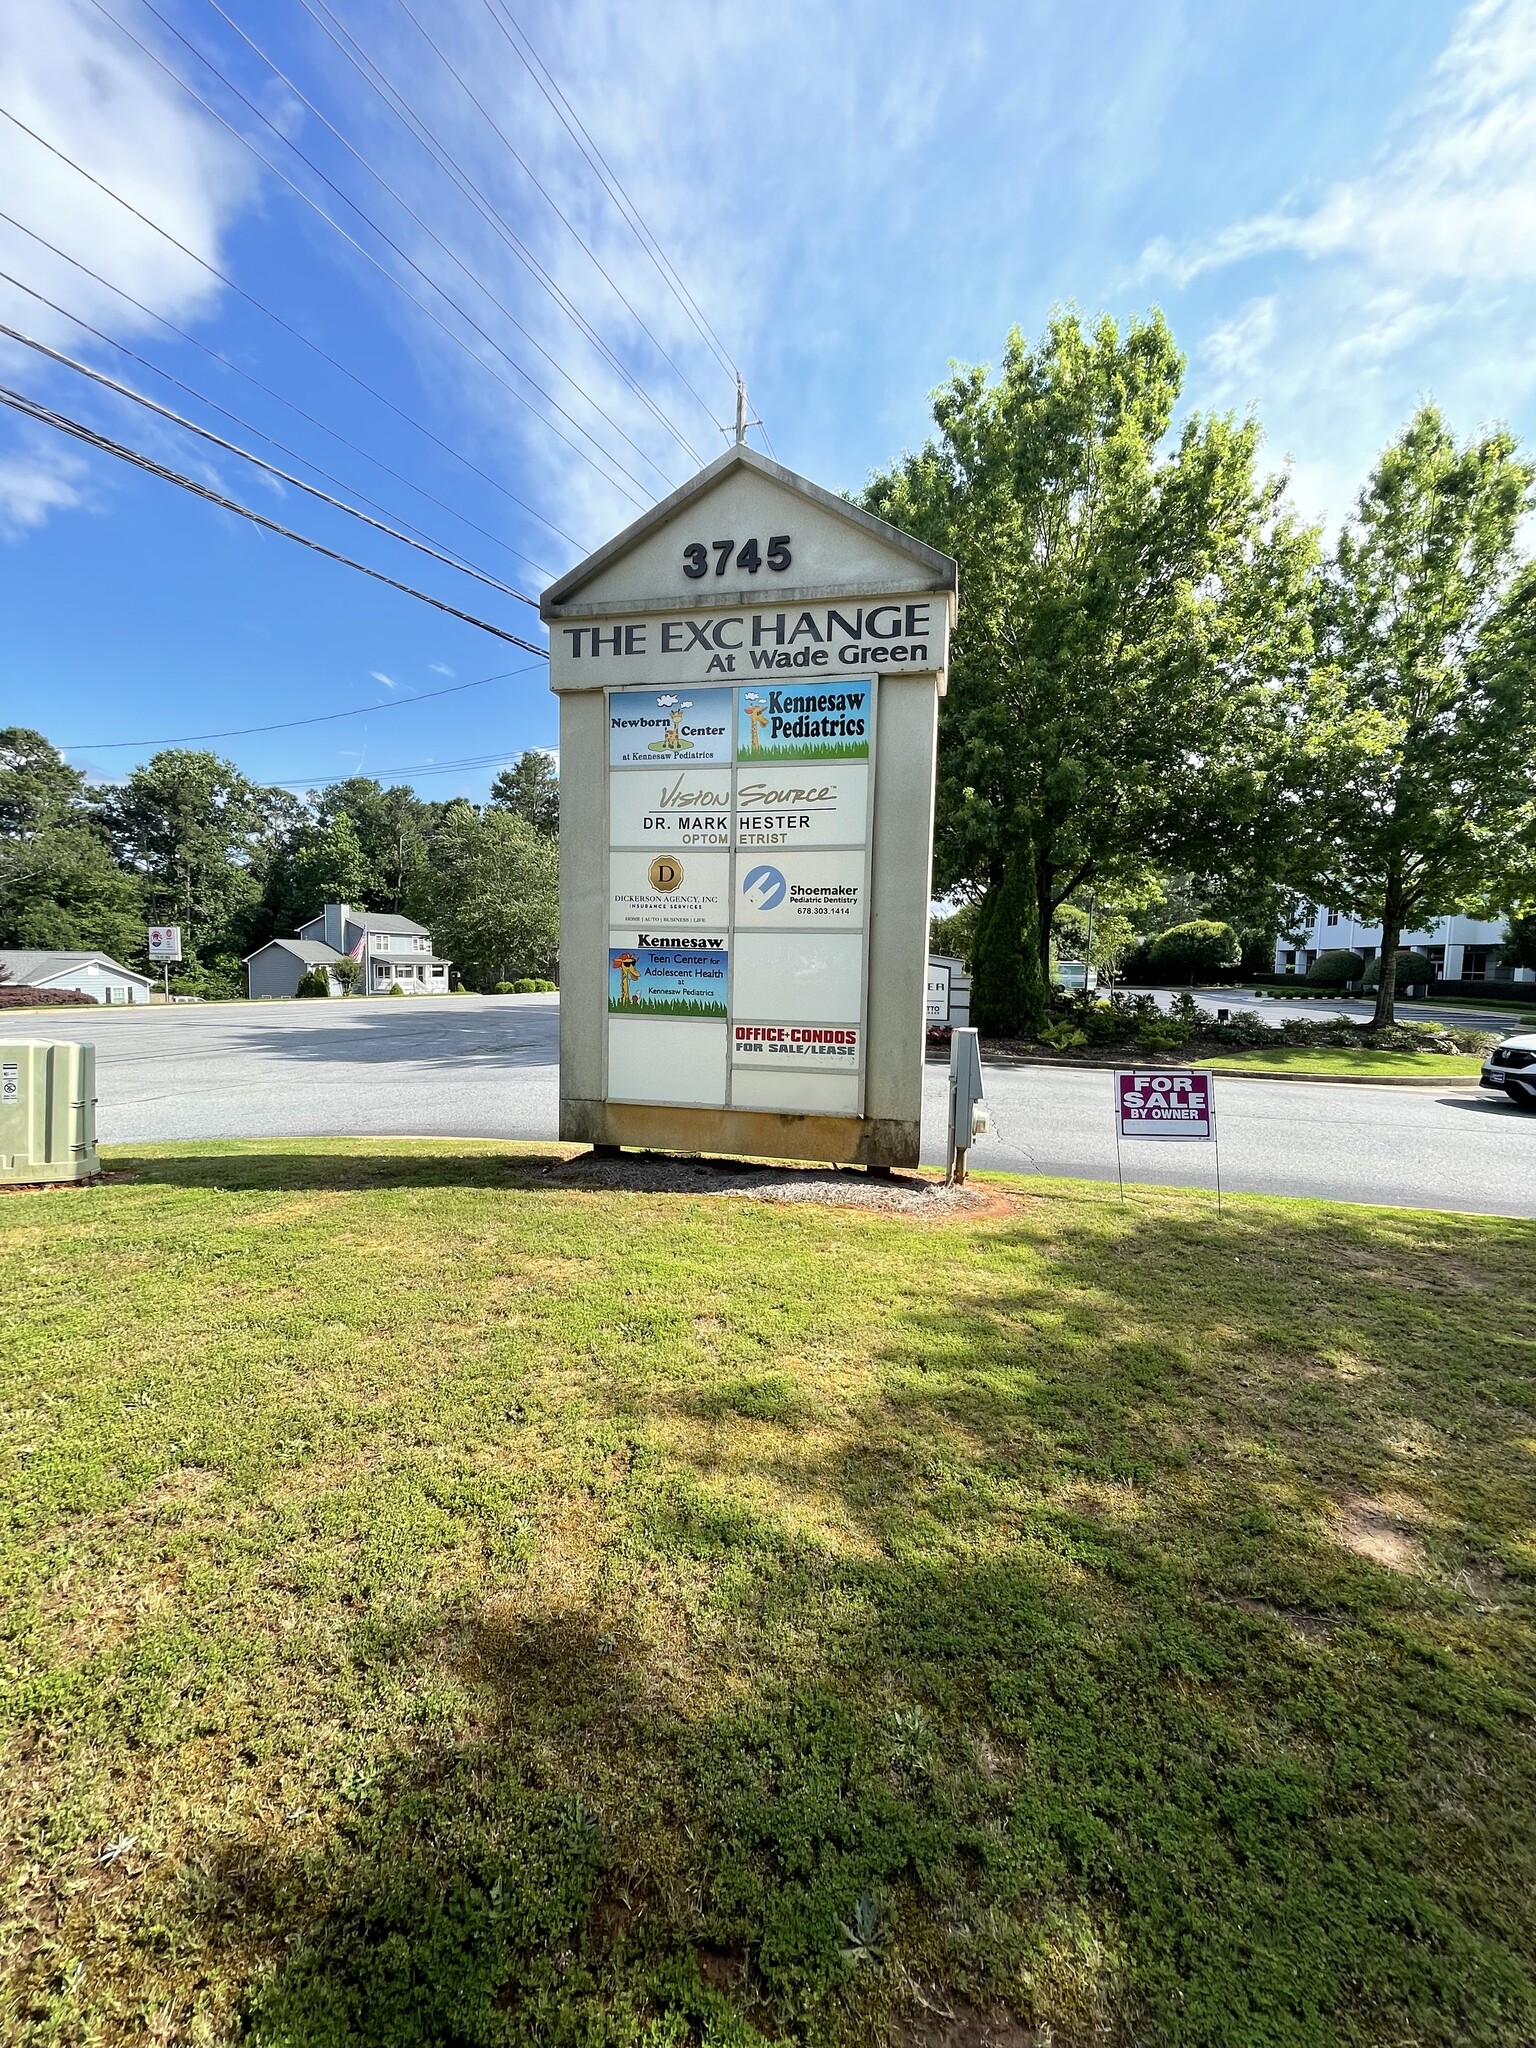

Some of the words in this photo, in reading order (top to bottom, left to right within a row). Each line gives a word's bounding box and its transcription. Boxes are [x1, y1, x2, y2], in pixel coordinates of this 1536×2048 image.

[683, 535, 791, 578] 3745
[563, 624, 646, 659] THE
[661, 603, 930, 653] EXCHANGE
[706, 653, 736, 674] At
[749, 645, 828, 670] Wade
[838, 644, 927, 664] Green
[768, 690, 865, 714] Kennesaw
[611, 717, 671, 728] Newborn
[770, 713, 865, 739] Pediatrics
[681, 726, 725, 736] Center
[632, 752, 672, 760] Kennesaw
[673, 751, 714, 760] Pediatrics
[643, 817, 671, 830] DR.
[678, 817, 728, 830] MARK
[739, 815, 811, 829] HESTER
[790, 885, 858, 896] Shoemaker
[664, 896, 700, 904] AGENCY,
[823, 897, 858, 905] Dentistry
[638, 934, 724, 948] Kennesaw
[648, 953, 671, 964] Teen
[674, 954, 708, 965] Center
[709, 957, 720, 965] for
[644, 968, 693, 977] Adolescent
[695, 970, 724, 978] Health
[648, 987, 681, 995] Kennesaw
[736, 1042, 763, 1052] FOR
[768, 1044, 855, 1055] SALE/LEASE
[1134, 1077, 1193, 1092] FOR
[1123, 1092, 1206, 1109] SALE
[1130, 1109, 1148, 1118] BY
[1151, 1109, 1199, 1120] OWNER
